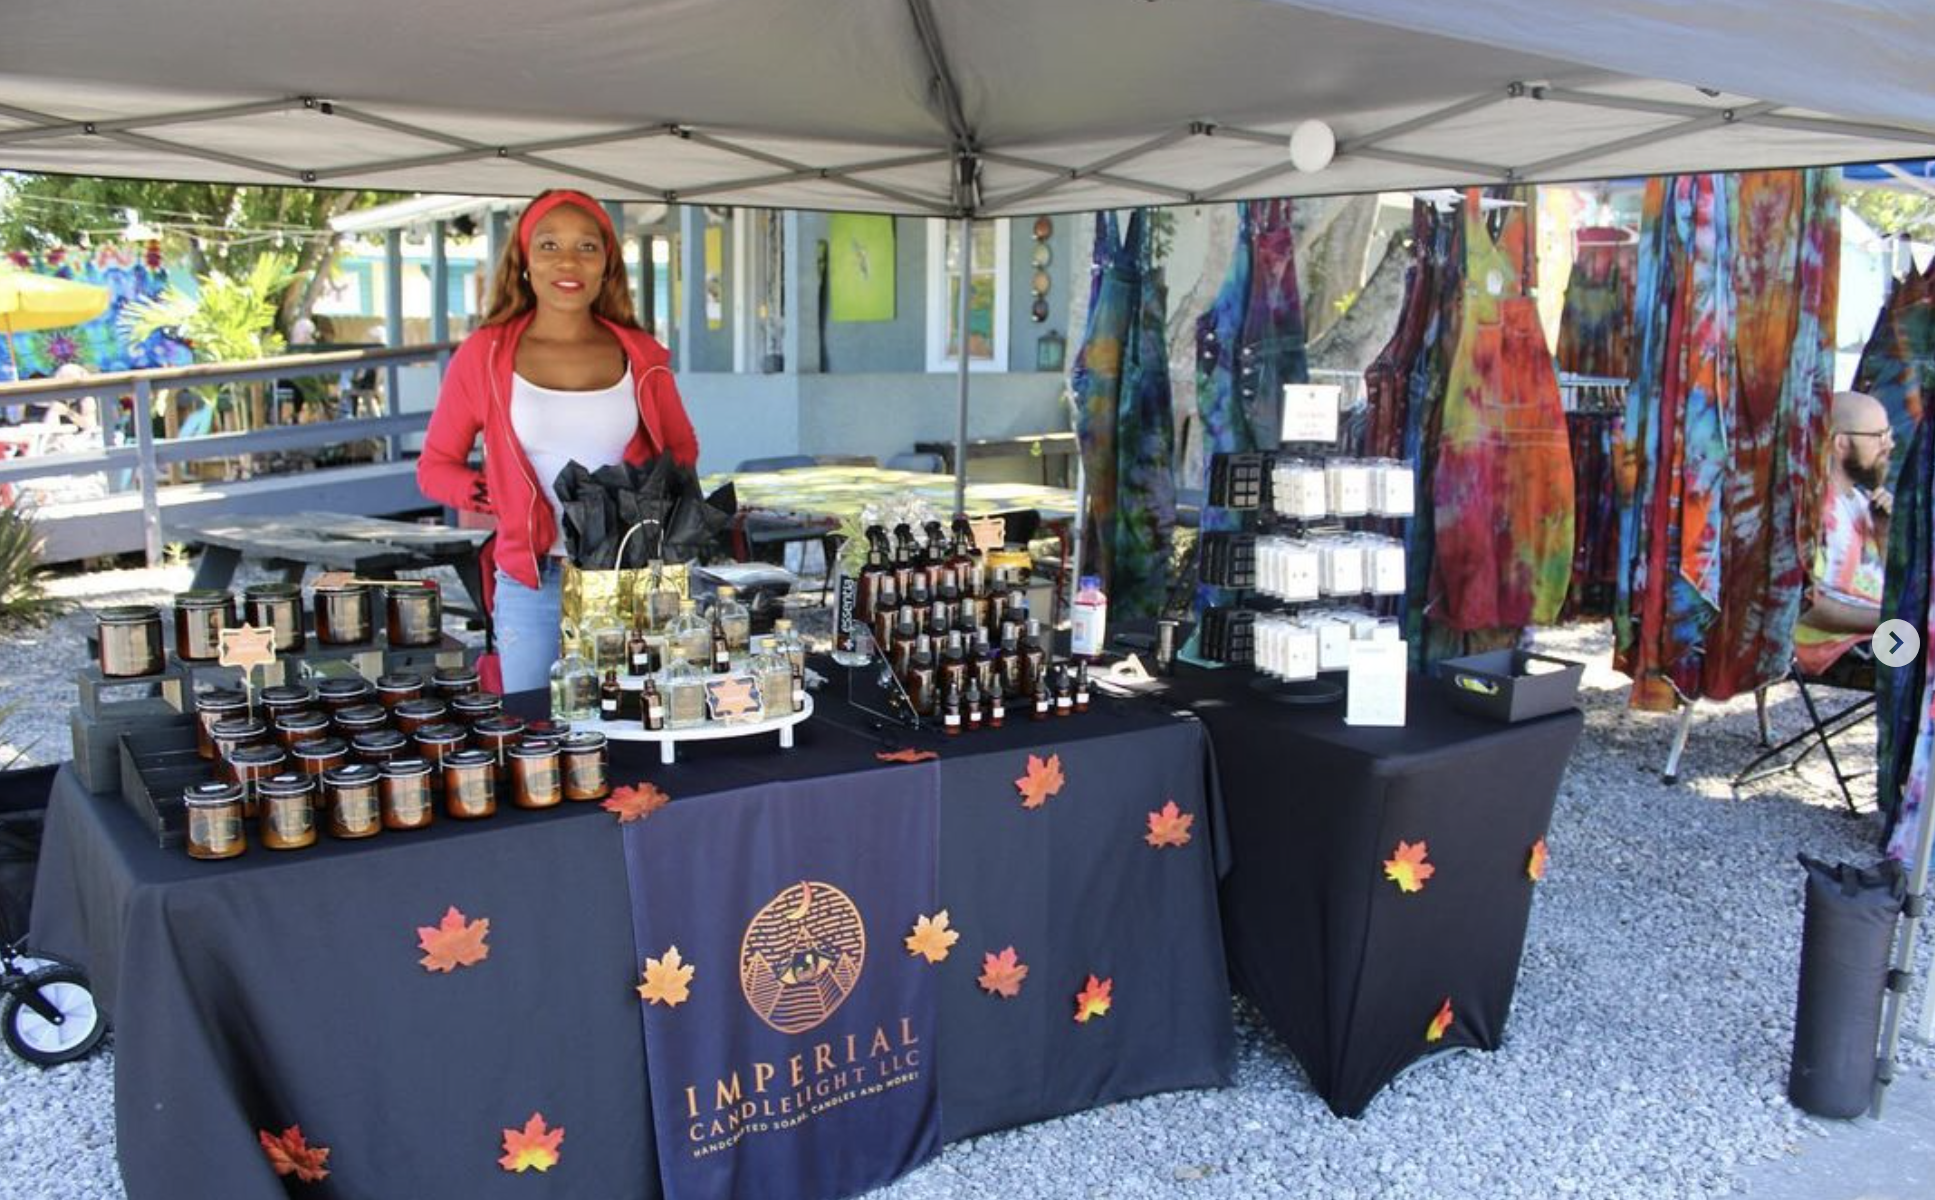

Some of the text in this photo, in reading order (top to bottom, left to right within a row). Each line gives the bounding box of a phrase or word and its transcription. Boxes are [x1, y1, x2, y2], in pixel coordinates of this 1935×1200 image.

[685, 1018, 919, 1118] IMPERIAL
[689, 1050, 920, 1142] CANDLELIGHT LLC
[693, 1123, 769, 1158] HANDCTED
[860, 1083, 884, 1097] AND
